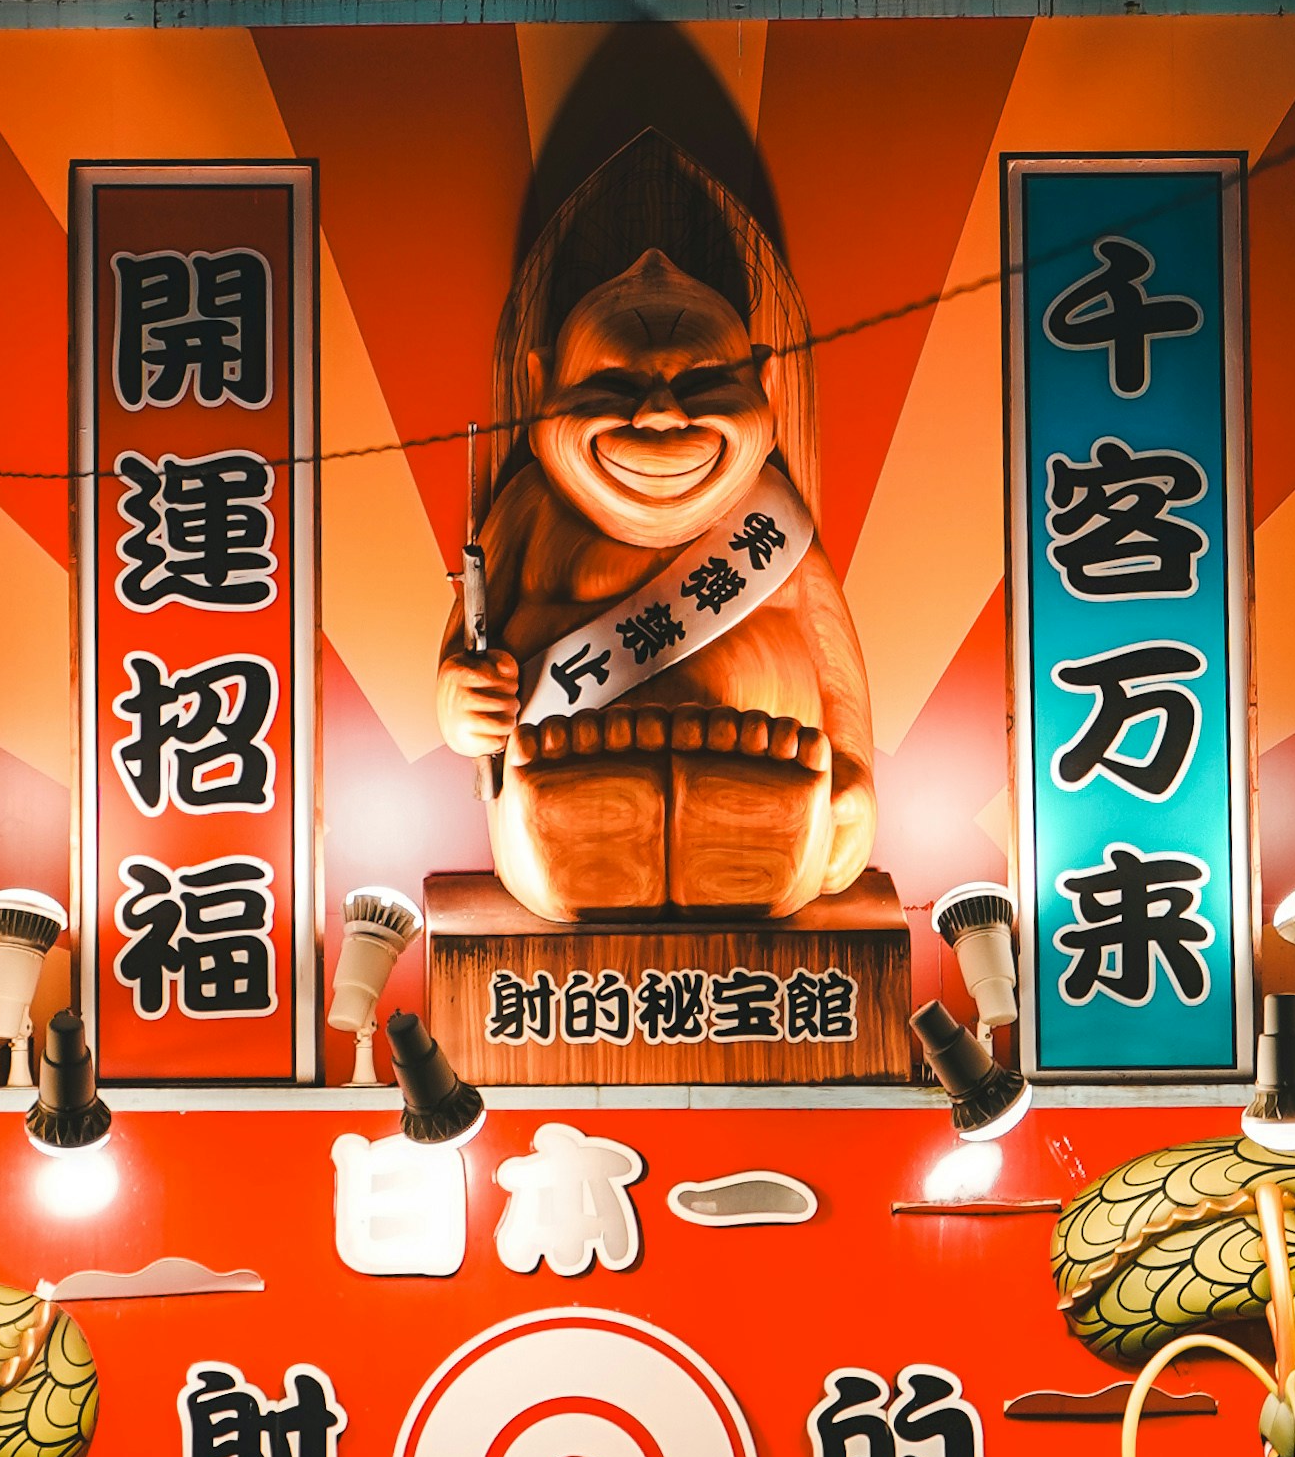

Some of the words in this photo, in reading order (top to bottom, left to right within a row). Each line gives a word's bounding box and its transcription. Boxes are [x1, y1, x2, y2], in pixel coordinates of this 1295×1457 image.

[110, 250, 280, 1021] 開運招福
[549, 510, 787, 706] 実弾禁止
[1042, 234, 1212, 1007] 千客万来
[485, 969, 858, 1045] 射的秘宝館
[330, 1120, 821, 1281] 日本一
